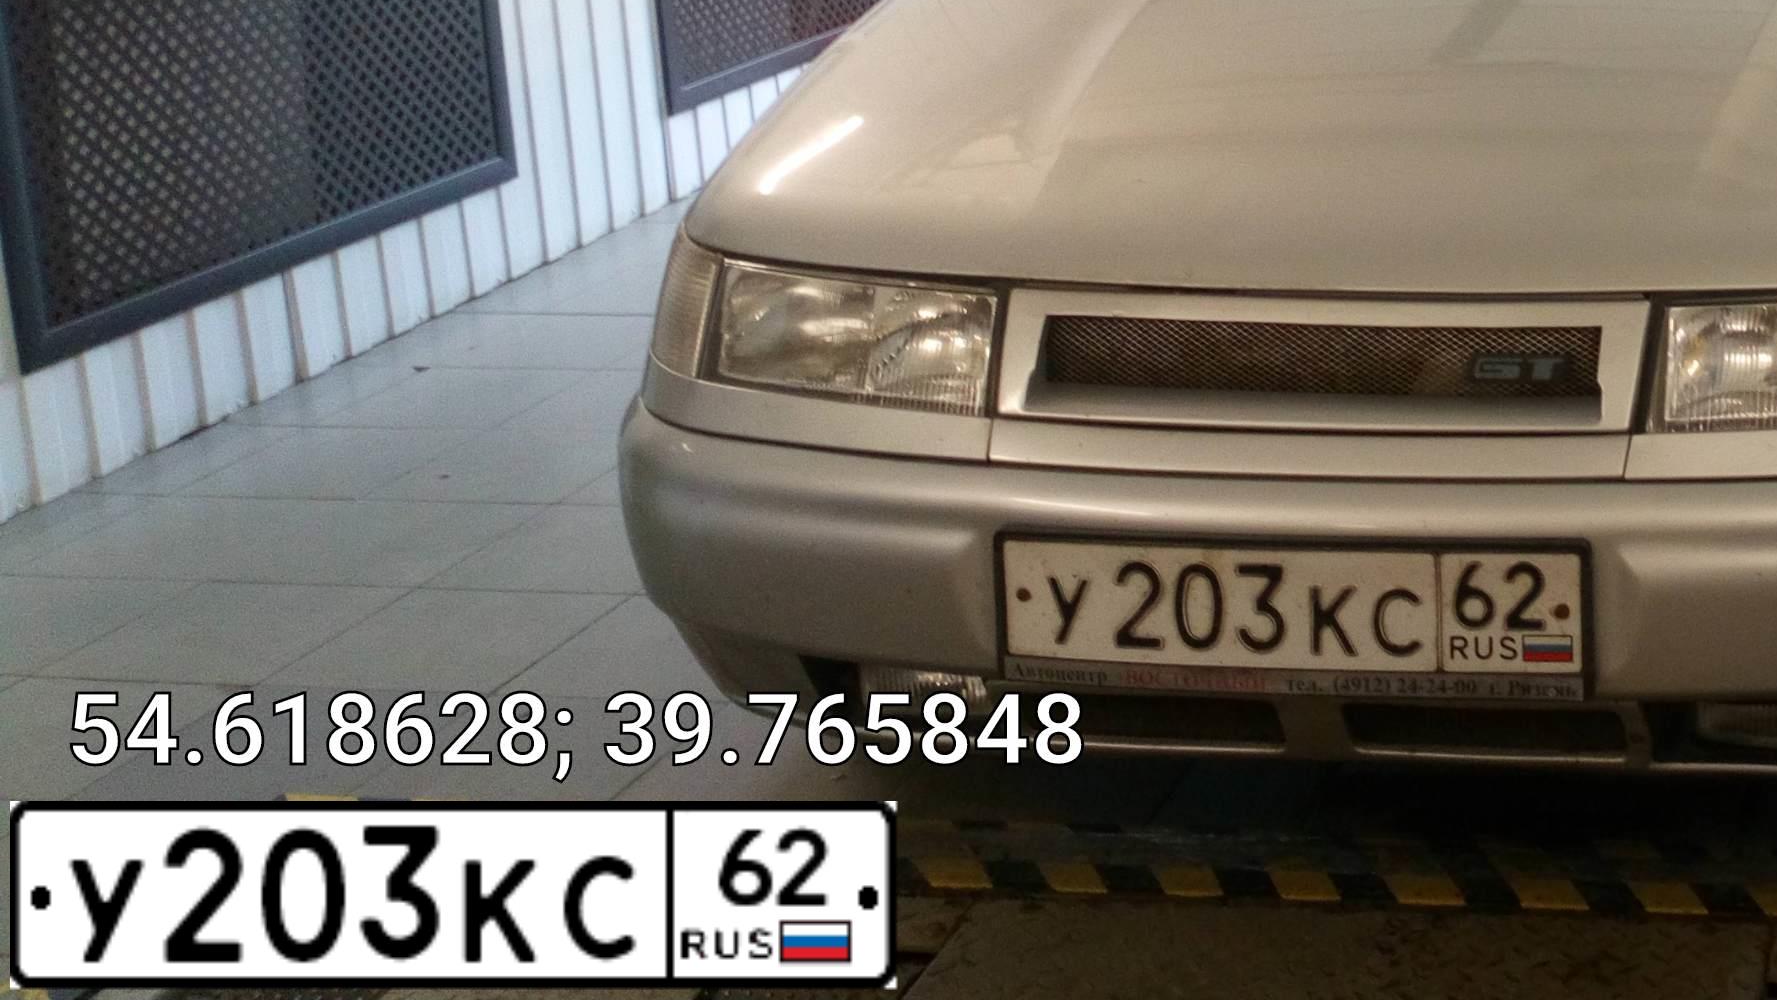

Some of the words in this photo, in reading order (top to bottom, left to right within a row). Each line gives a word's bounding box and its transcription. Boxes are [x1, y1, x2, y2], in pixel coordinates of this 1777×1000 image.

[1474, 357, 1565, 380] GT
[1453, 561, 1547, 632] 62
[1449, 635, 1518, 661] RUS
